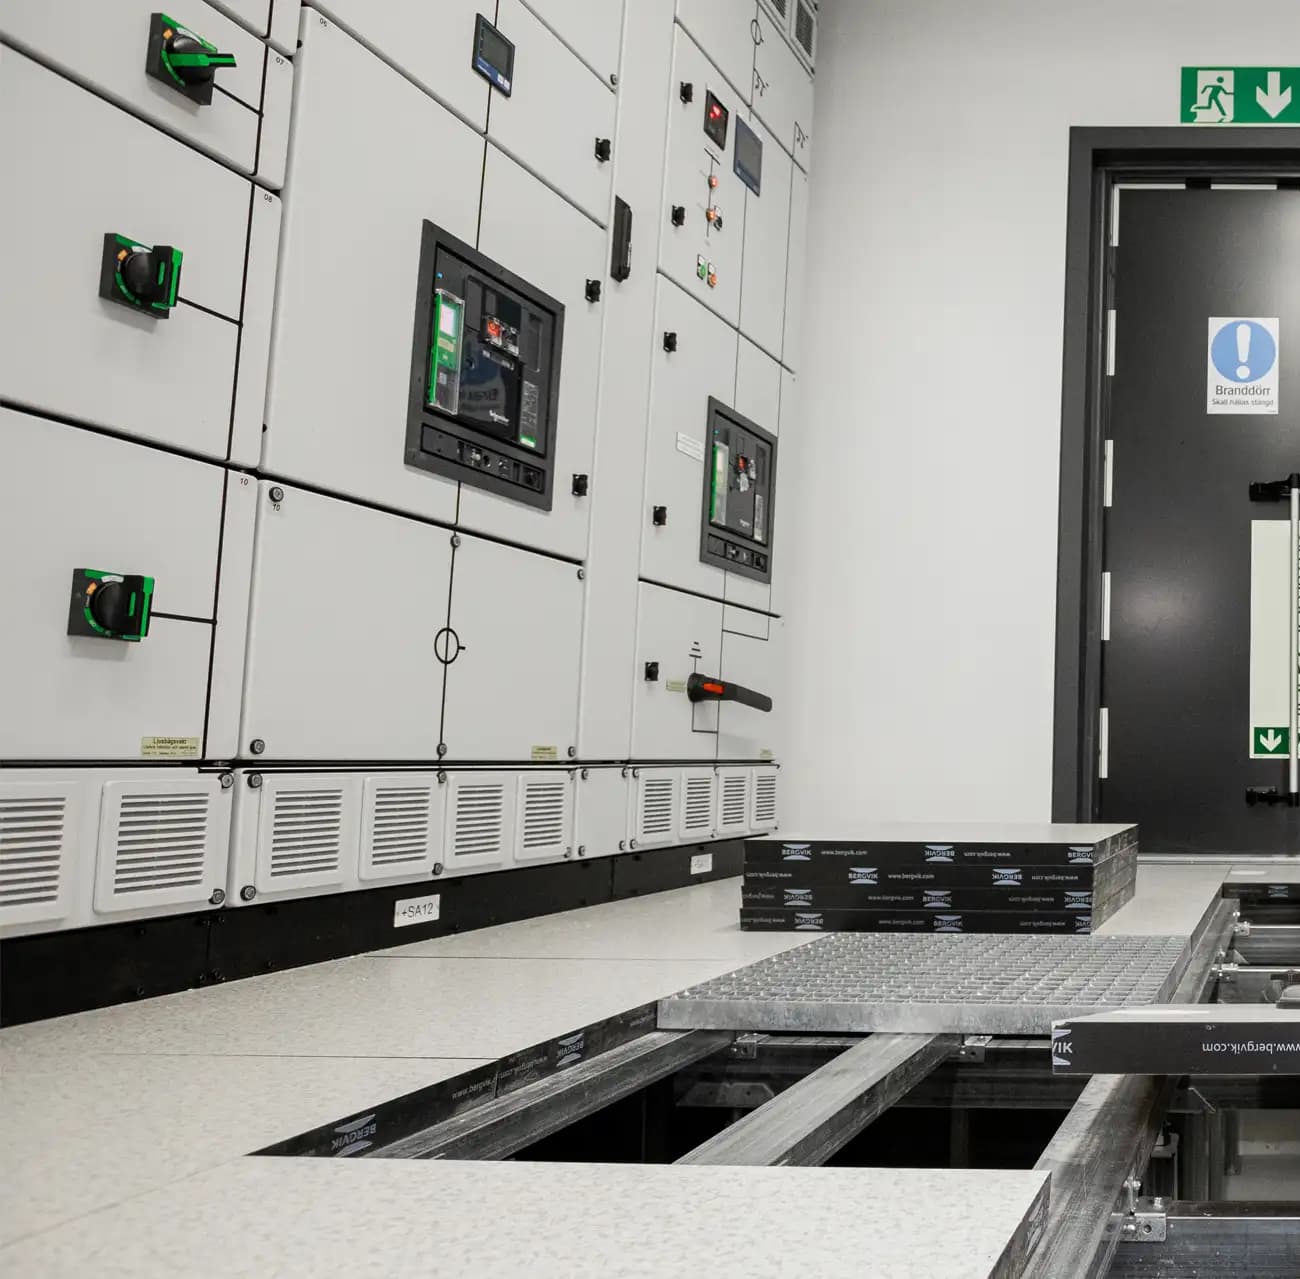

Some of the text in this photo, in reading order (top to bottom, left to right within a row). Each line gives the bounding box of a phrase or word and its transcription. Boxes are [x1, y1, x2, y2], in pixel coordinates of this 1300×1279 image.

[1215, 384, 1271, 396] Branddörr
[401, 902, 434, 918] +SA12
[331, 1122, 378, 1151] BERGVIK
